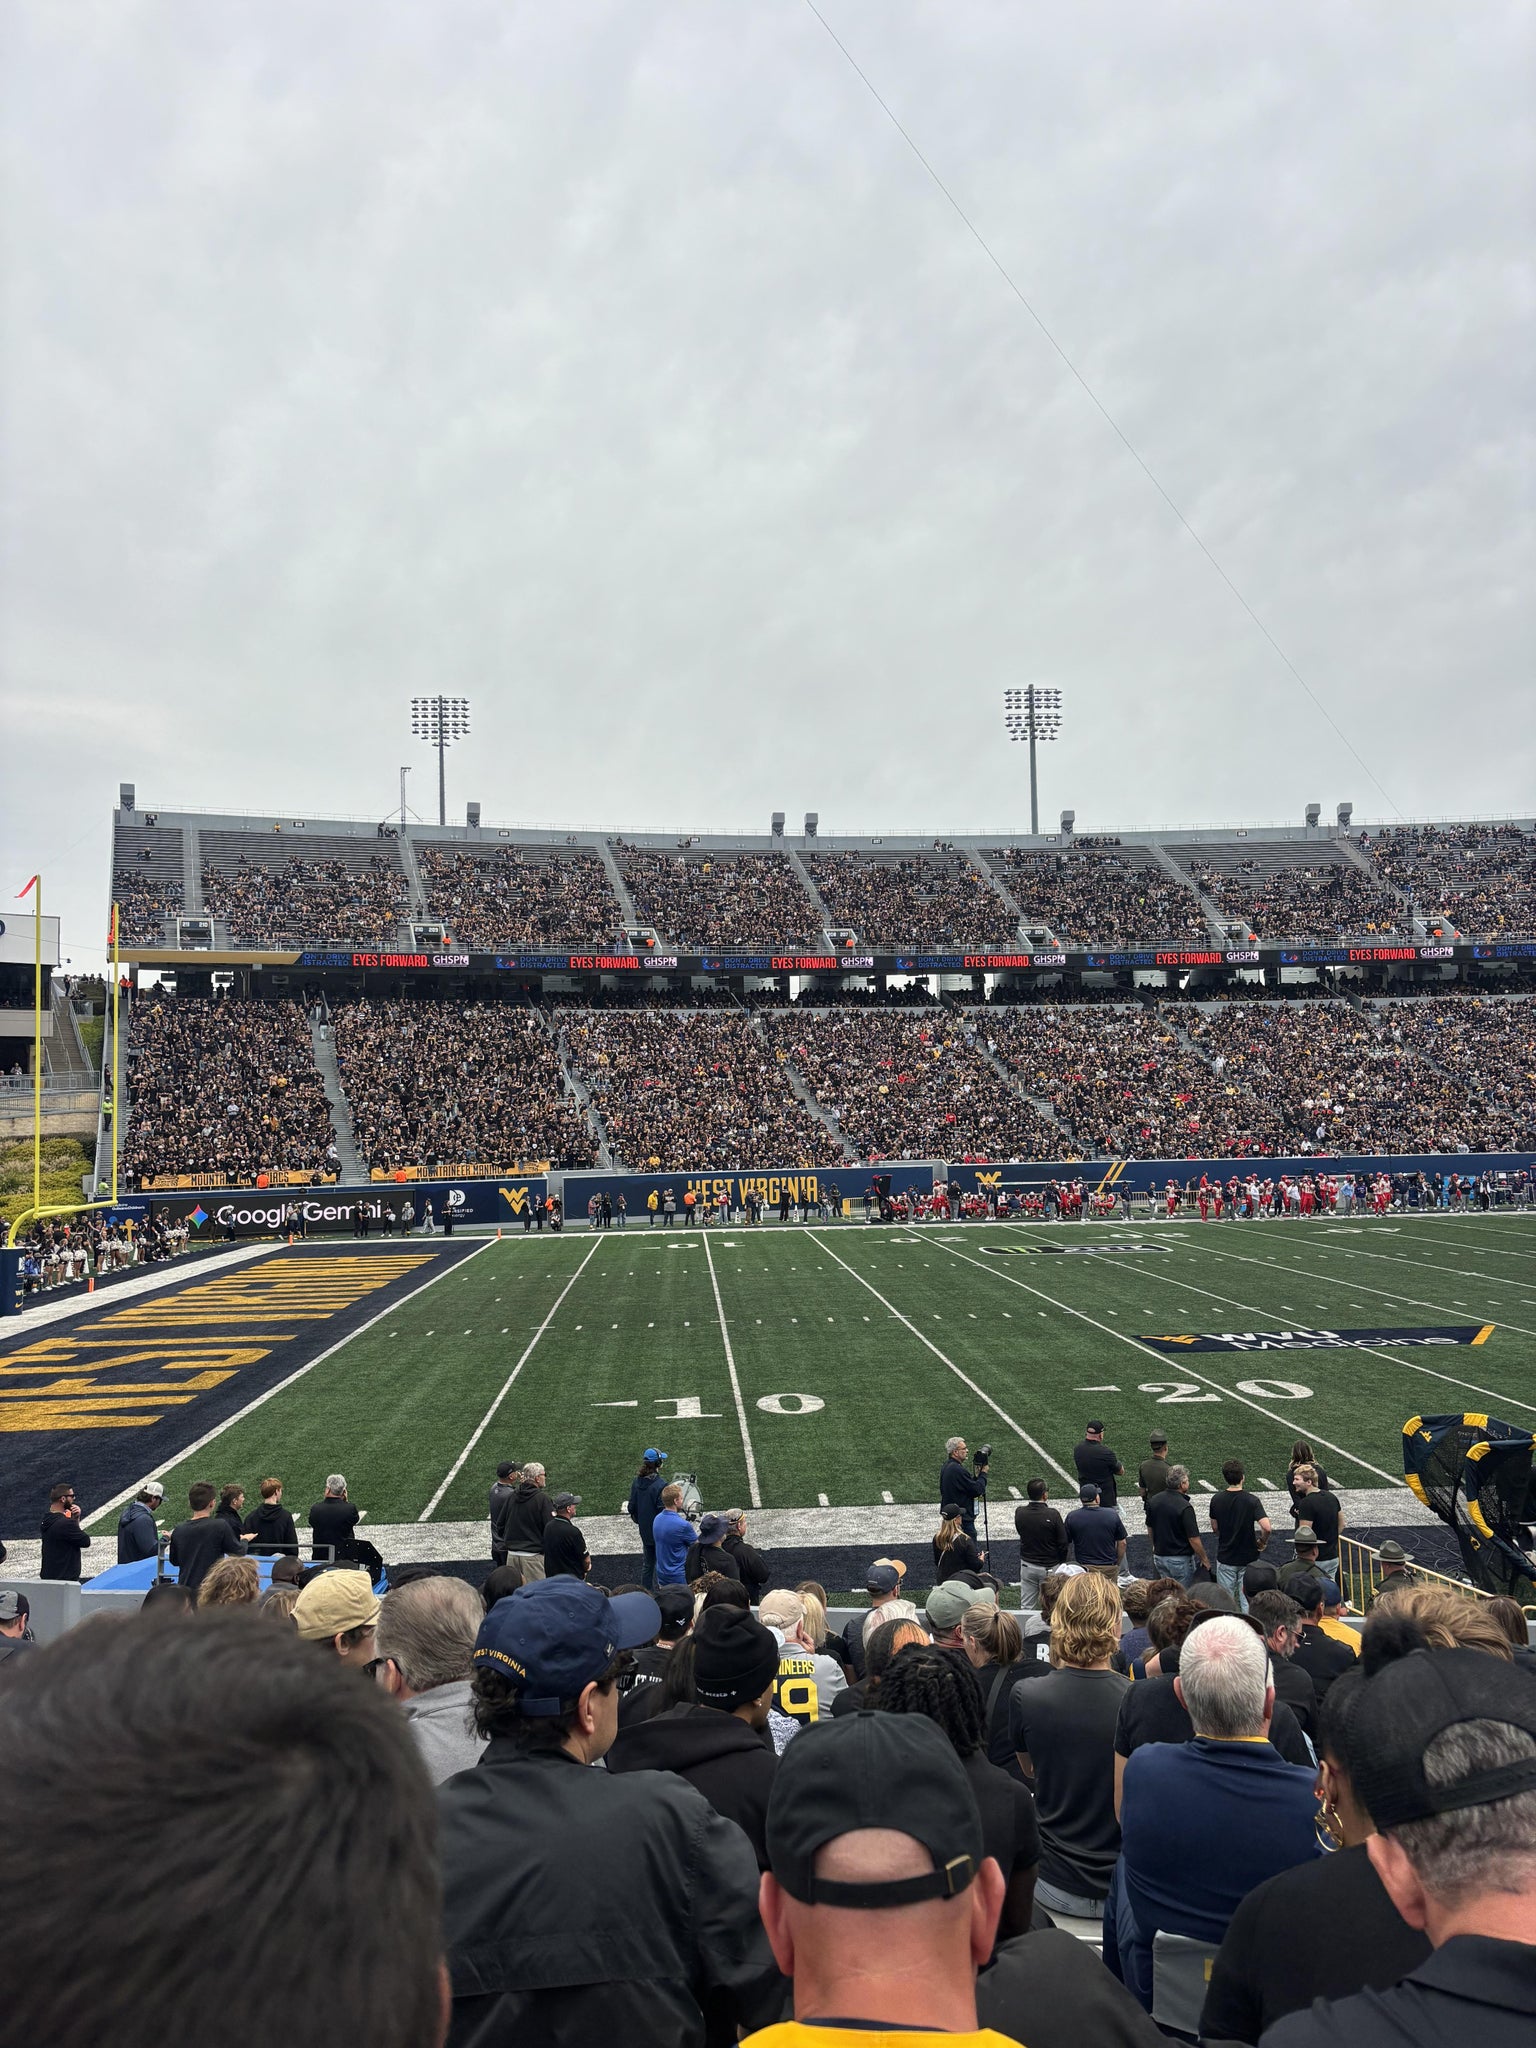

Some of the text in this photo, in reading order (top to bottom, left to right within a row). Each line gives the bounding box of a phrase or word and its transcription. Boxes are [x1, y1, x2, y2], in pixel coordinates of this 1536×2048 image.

[1156, 952, 1224, 965] EYES FORWARD.
[1226, 951, 1252, 961] GHSP
[1349, 948, 1418, 961] EYES FORWARD.
[1420, 947, 1446, 957] GHSP
[353, 954, 430, 967] EYES FORWARD.
[433, 955, 460, 965] GHSP
[570, 956, 641, 969] EYES FORWARD.
[643, 957, 669, 967] GHSP
[771, 957, 839, 969] EYES FORWARD.
[841, 957, 866, 966] GHSP
[964, 955, 1031, 968] EYES FORWARD.
[1033, 955, 1058, 965] GHSP
[738, 1175, 818, 1205] VIRGINIA
[1200, 1330, 1341, 1343] WVU
[1228, 1336, 1460, 1350] Medicine
[489, 1649, 526, 1679] VIRGINIA
[772, 1677, 820, 1722] 9
